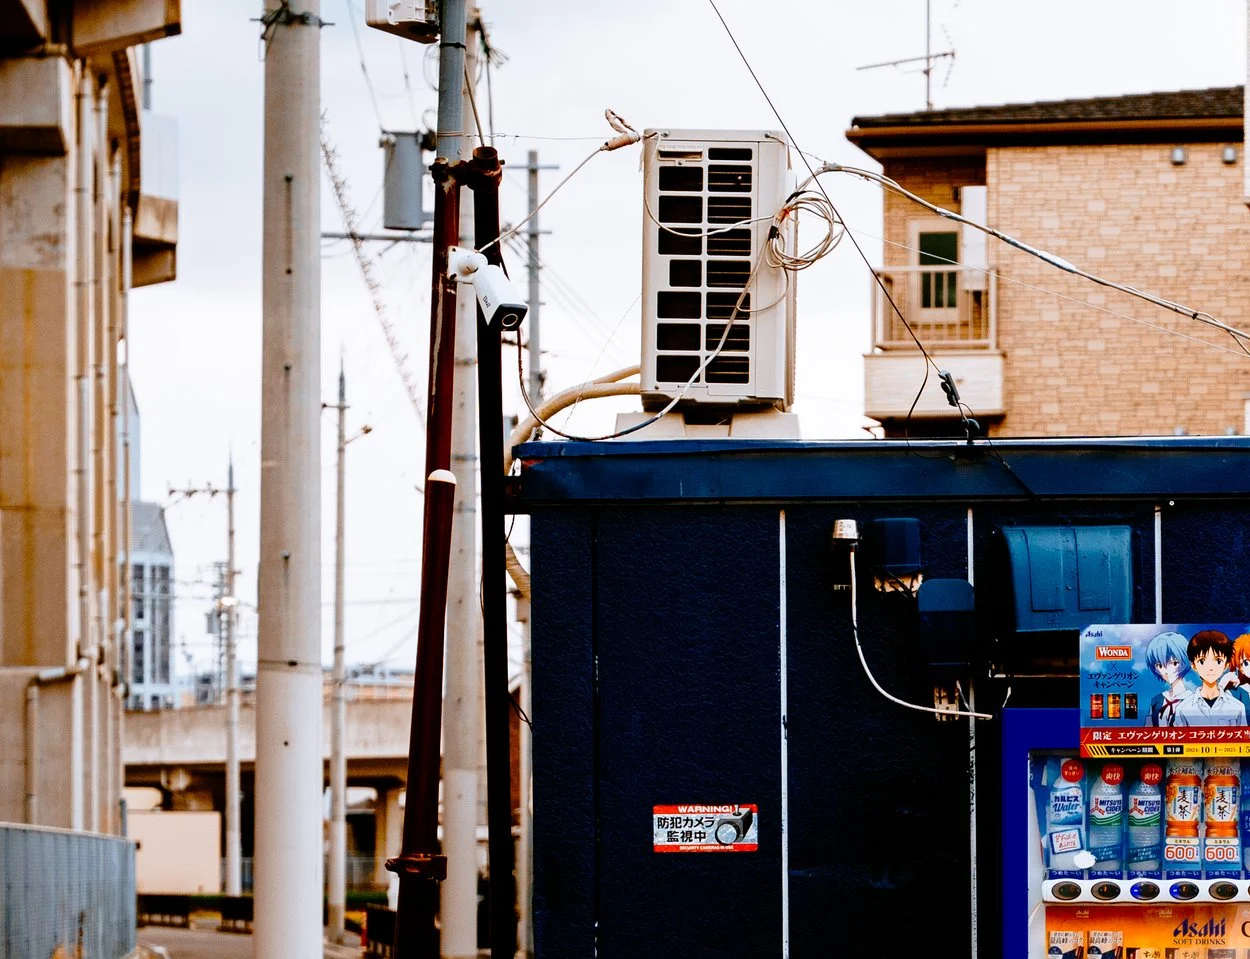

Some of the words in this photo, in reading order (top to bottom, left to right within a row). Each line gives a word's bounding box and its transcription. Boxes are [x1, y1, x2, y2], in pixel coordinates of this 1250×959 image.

[1098, 646, 1128, 657] WONDA
[1087, 673, 1140, 681] エヴァンゲリオン
[1092, 731, 1112, 740] 限定
[1118, 731, 1186, 740] エヴァンゲリオン
[1052, 802, 1080, 813] Water
[1177, 788, 1191, 820] 麦茶
[1216, 789, 1231, 820] 麦茶
[657, 816, 715, 829] 防犯カメラ
[666, 830, 707, 843] 監視中
[1166, 846, 1195, 859] 600
[1205, 847, 1235, 860] 600
[1173, 917, 1226, 937] Asahi
